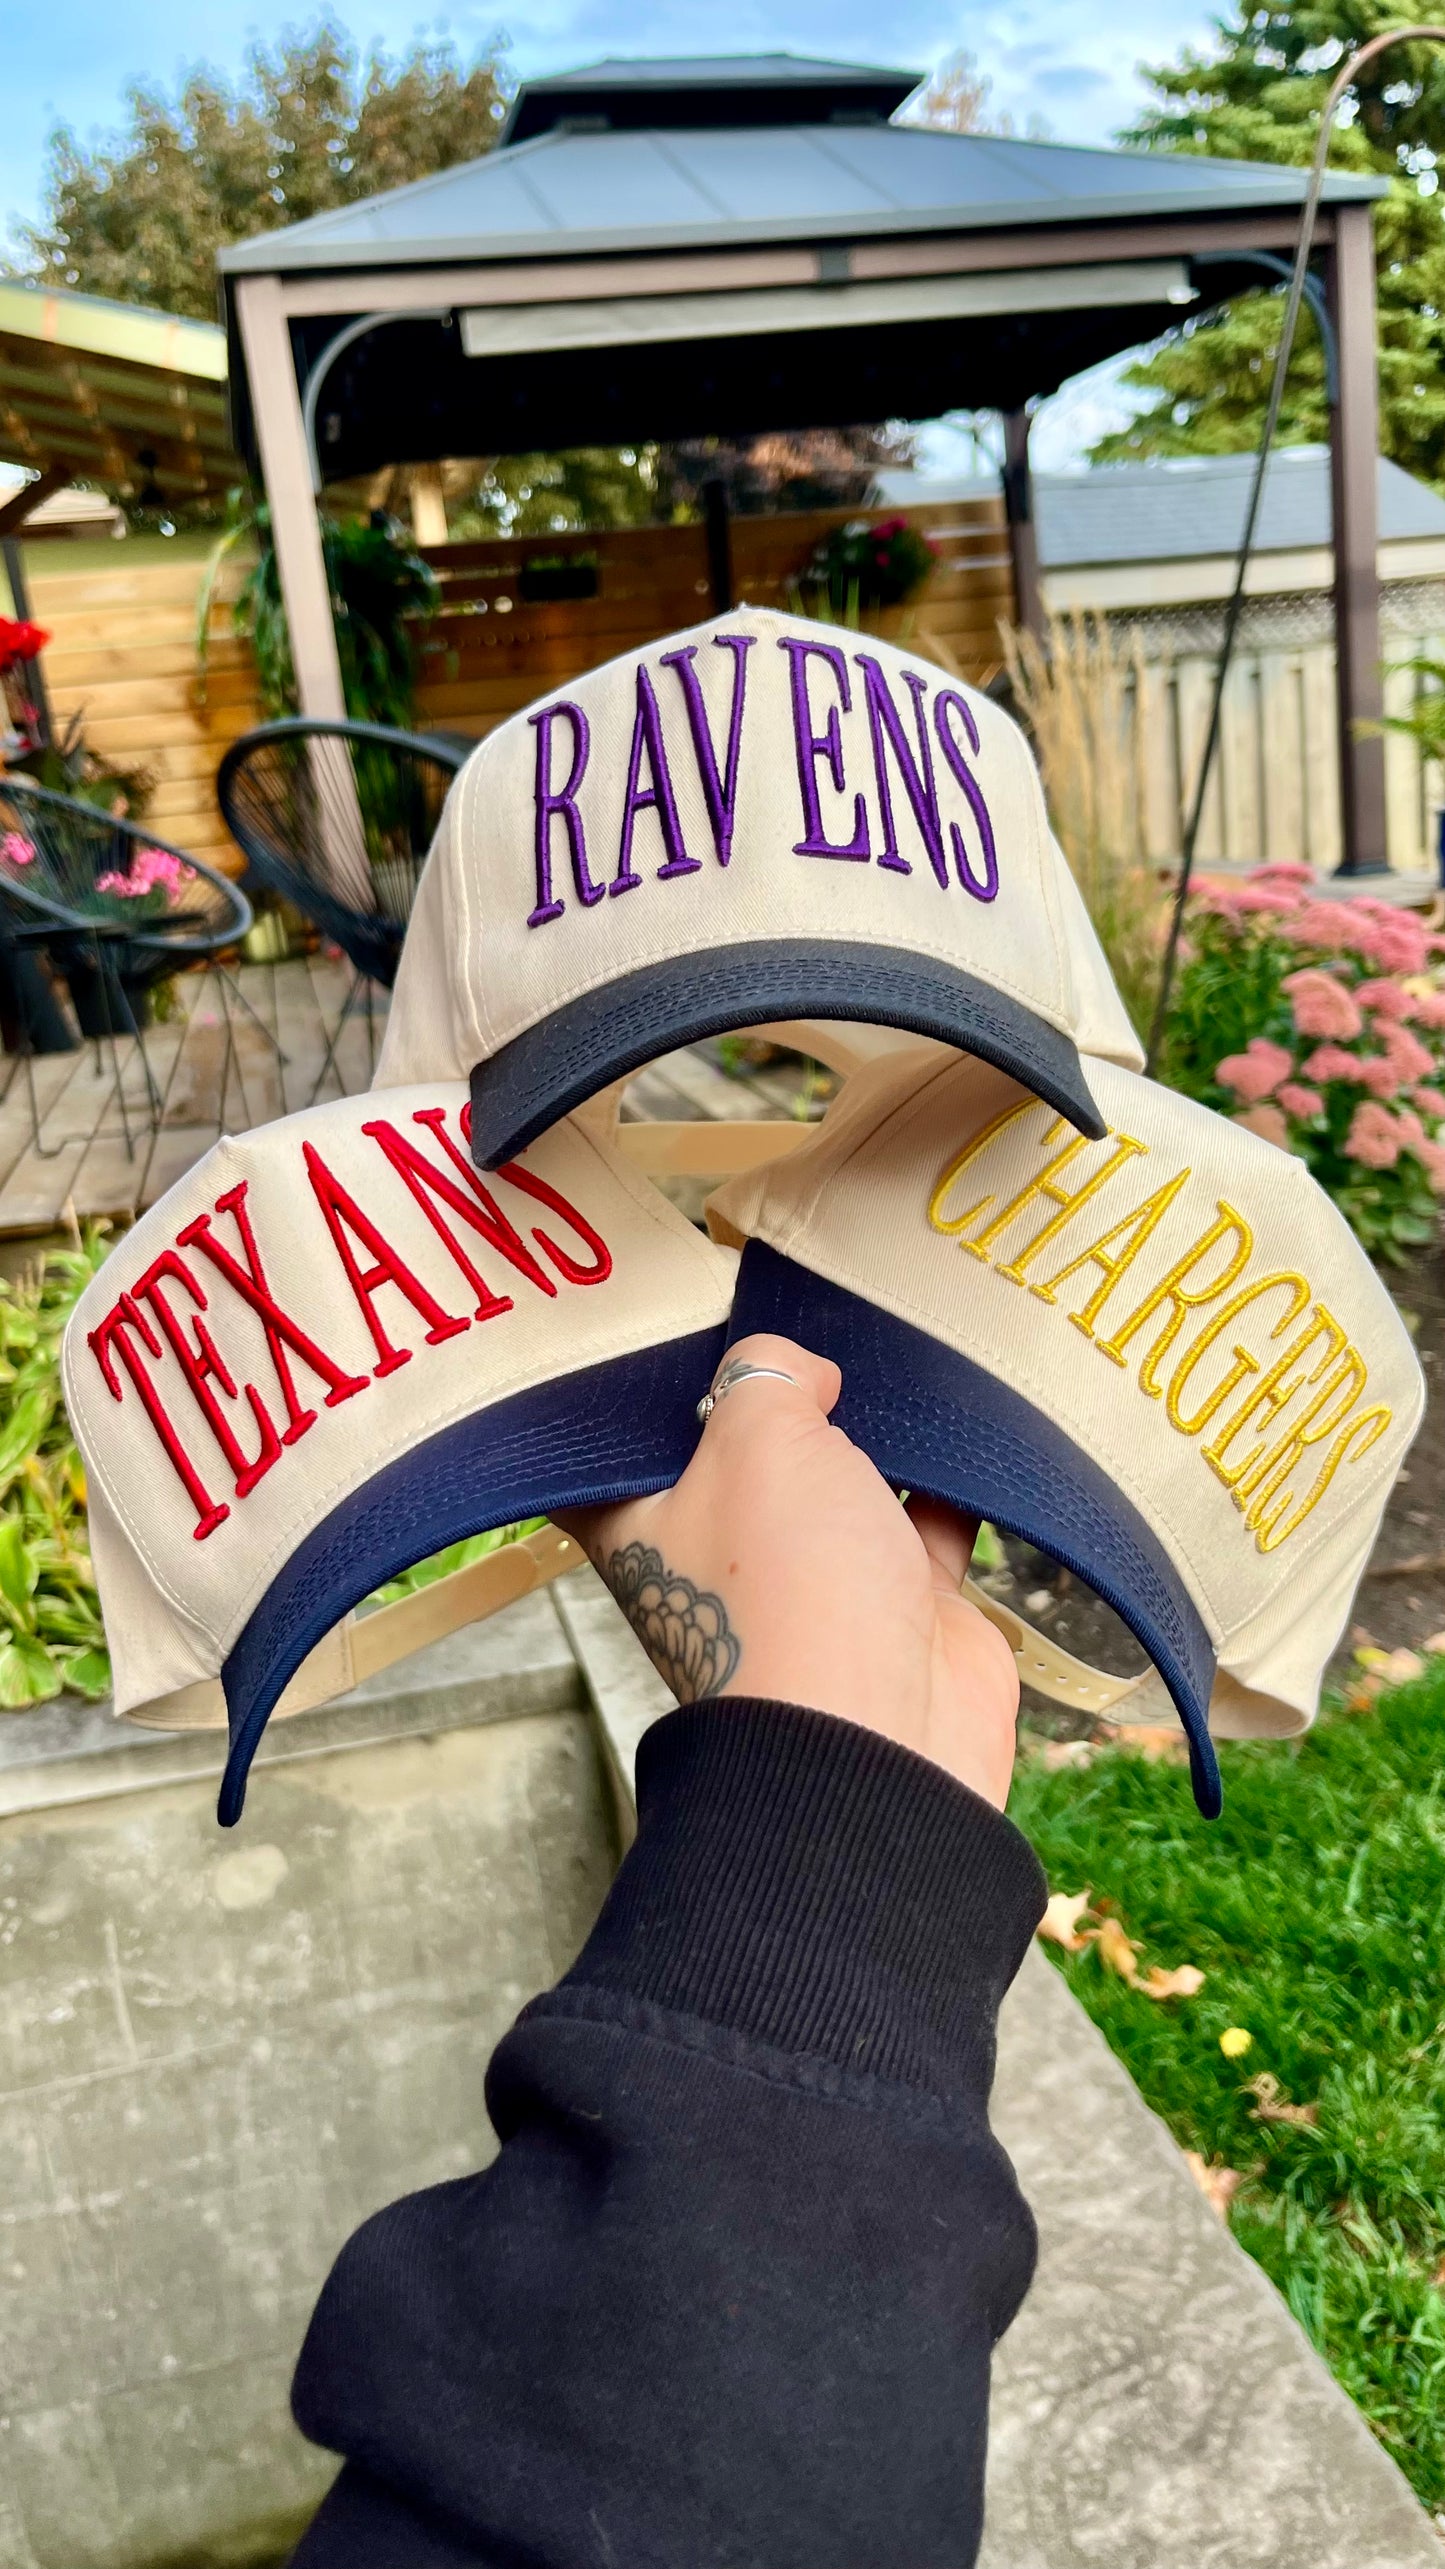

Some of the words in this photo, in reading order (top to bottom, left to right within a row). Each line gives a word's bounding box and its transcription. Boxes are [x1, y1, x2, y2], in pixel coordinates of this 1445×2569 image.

[526, 634, 999, 928] RAVENS
[87, 1100, 613, 1541] TEXANS
[927, 1095, 1392, 1554] CHARGERS
